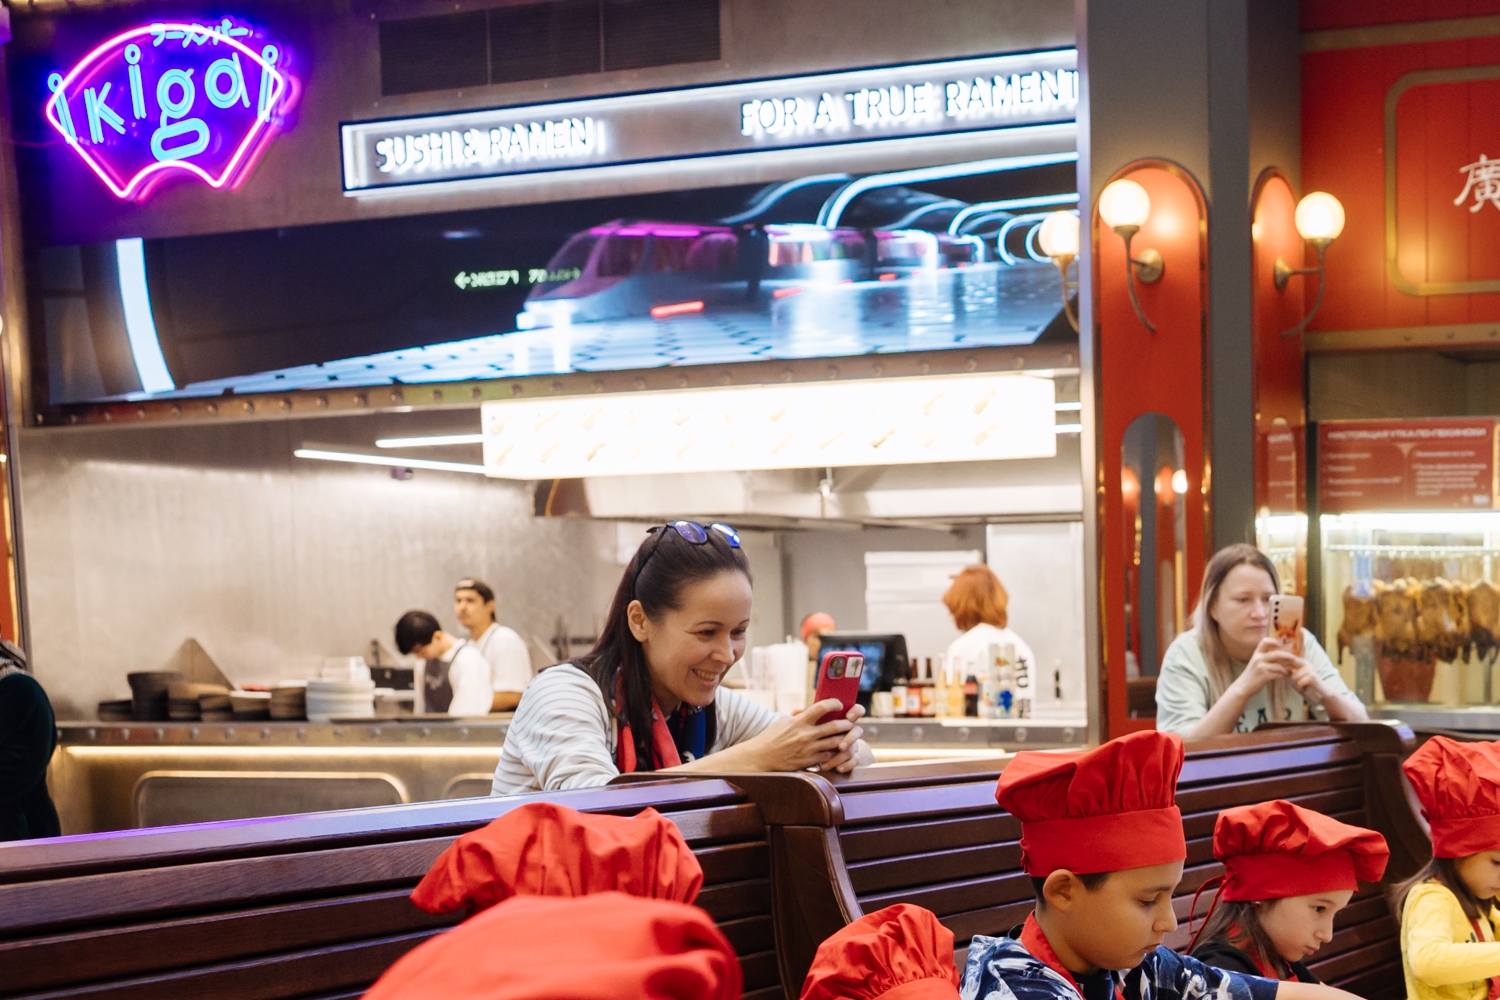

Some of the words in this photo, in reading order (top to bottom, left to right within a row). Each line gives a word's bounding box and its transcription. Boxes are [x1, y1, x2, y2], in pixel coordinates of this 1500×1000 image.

[741, 96, 804, 136] FOR
[813, 92, 842, 130] A
[845, 81, 936, 126] TRUE
[376, 131, 459, 173] SUSHI
[463, 128, 483, 165] &
[489, 117, 596, 158] RAMEN
